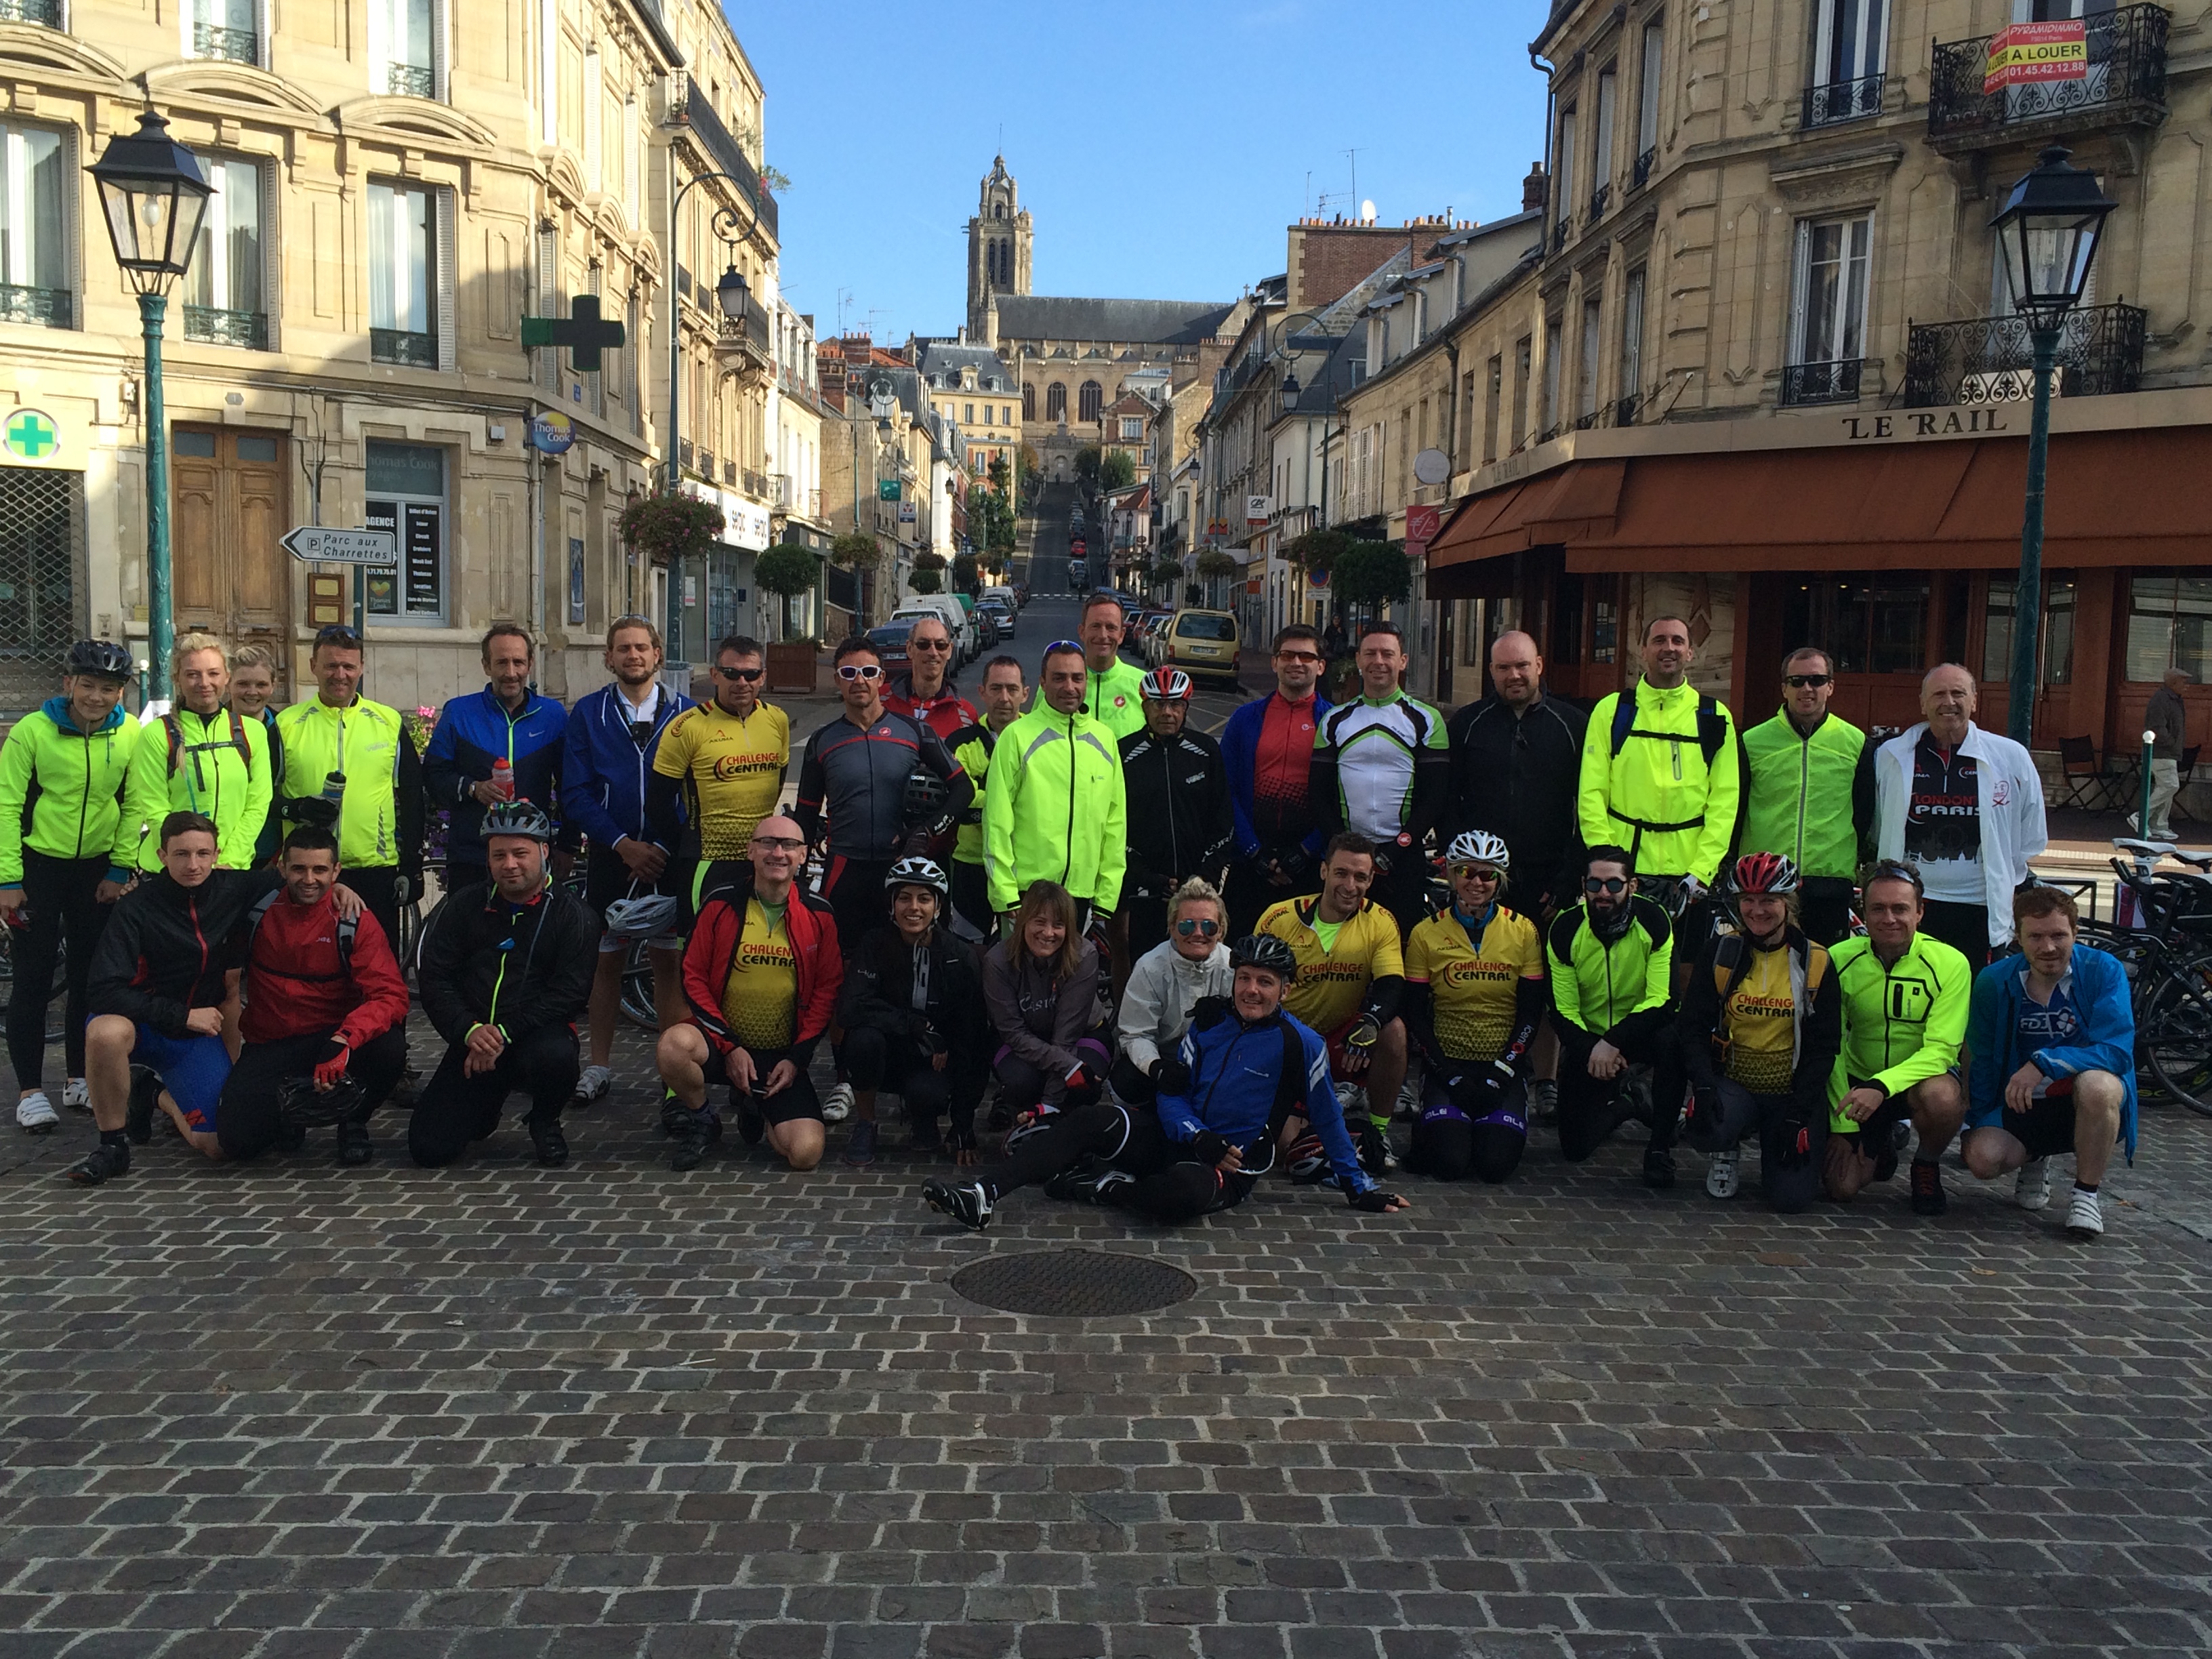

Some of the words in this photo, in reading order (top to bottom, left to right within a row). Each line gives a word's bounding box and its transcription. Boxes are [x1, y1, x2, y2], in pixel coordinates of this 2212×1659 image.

[2010, 22, 2083, 35] PYRAMIDIMMO
[2011, 49, 2023, 60] A
[2028, 44, 2082, 60] LOUER
[2009, 62, 2085, 77] 01.45.42.12.88
[533, 423, 571, 433] Thomas
[1842, 415, 1893, 439] LE
[1908, 409, 2008, 436] RAIL
[547, 432, 571, 443] Cook
[367, 454, 407, 468] homas
[366, 516, 395, 527] AGENCE
[324, 534, 350, 545] Parc
[358, 538, 377, 547] aux
[323, 546, 388, 560] Charrettes
[726, 752, 779, 765] CHALLENGE
[726, 762, 779, 774] CENTRAL
[1915, 795, 1973, 805] LONDON
[743, 944, 791, 957] CHALLEN
[742, 955, 796, 968] CENTRA
[1454, 962, 1512, 972] CHALLENGE
[1303, 962, 1364, 975] CHALLENGE
[1303, 972, 1361, 983] CENTRAL
[1454, 971, 1511, 981] CENTRAL
